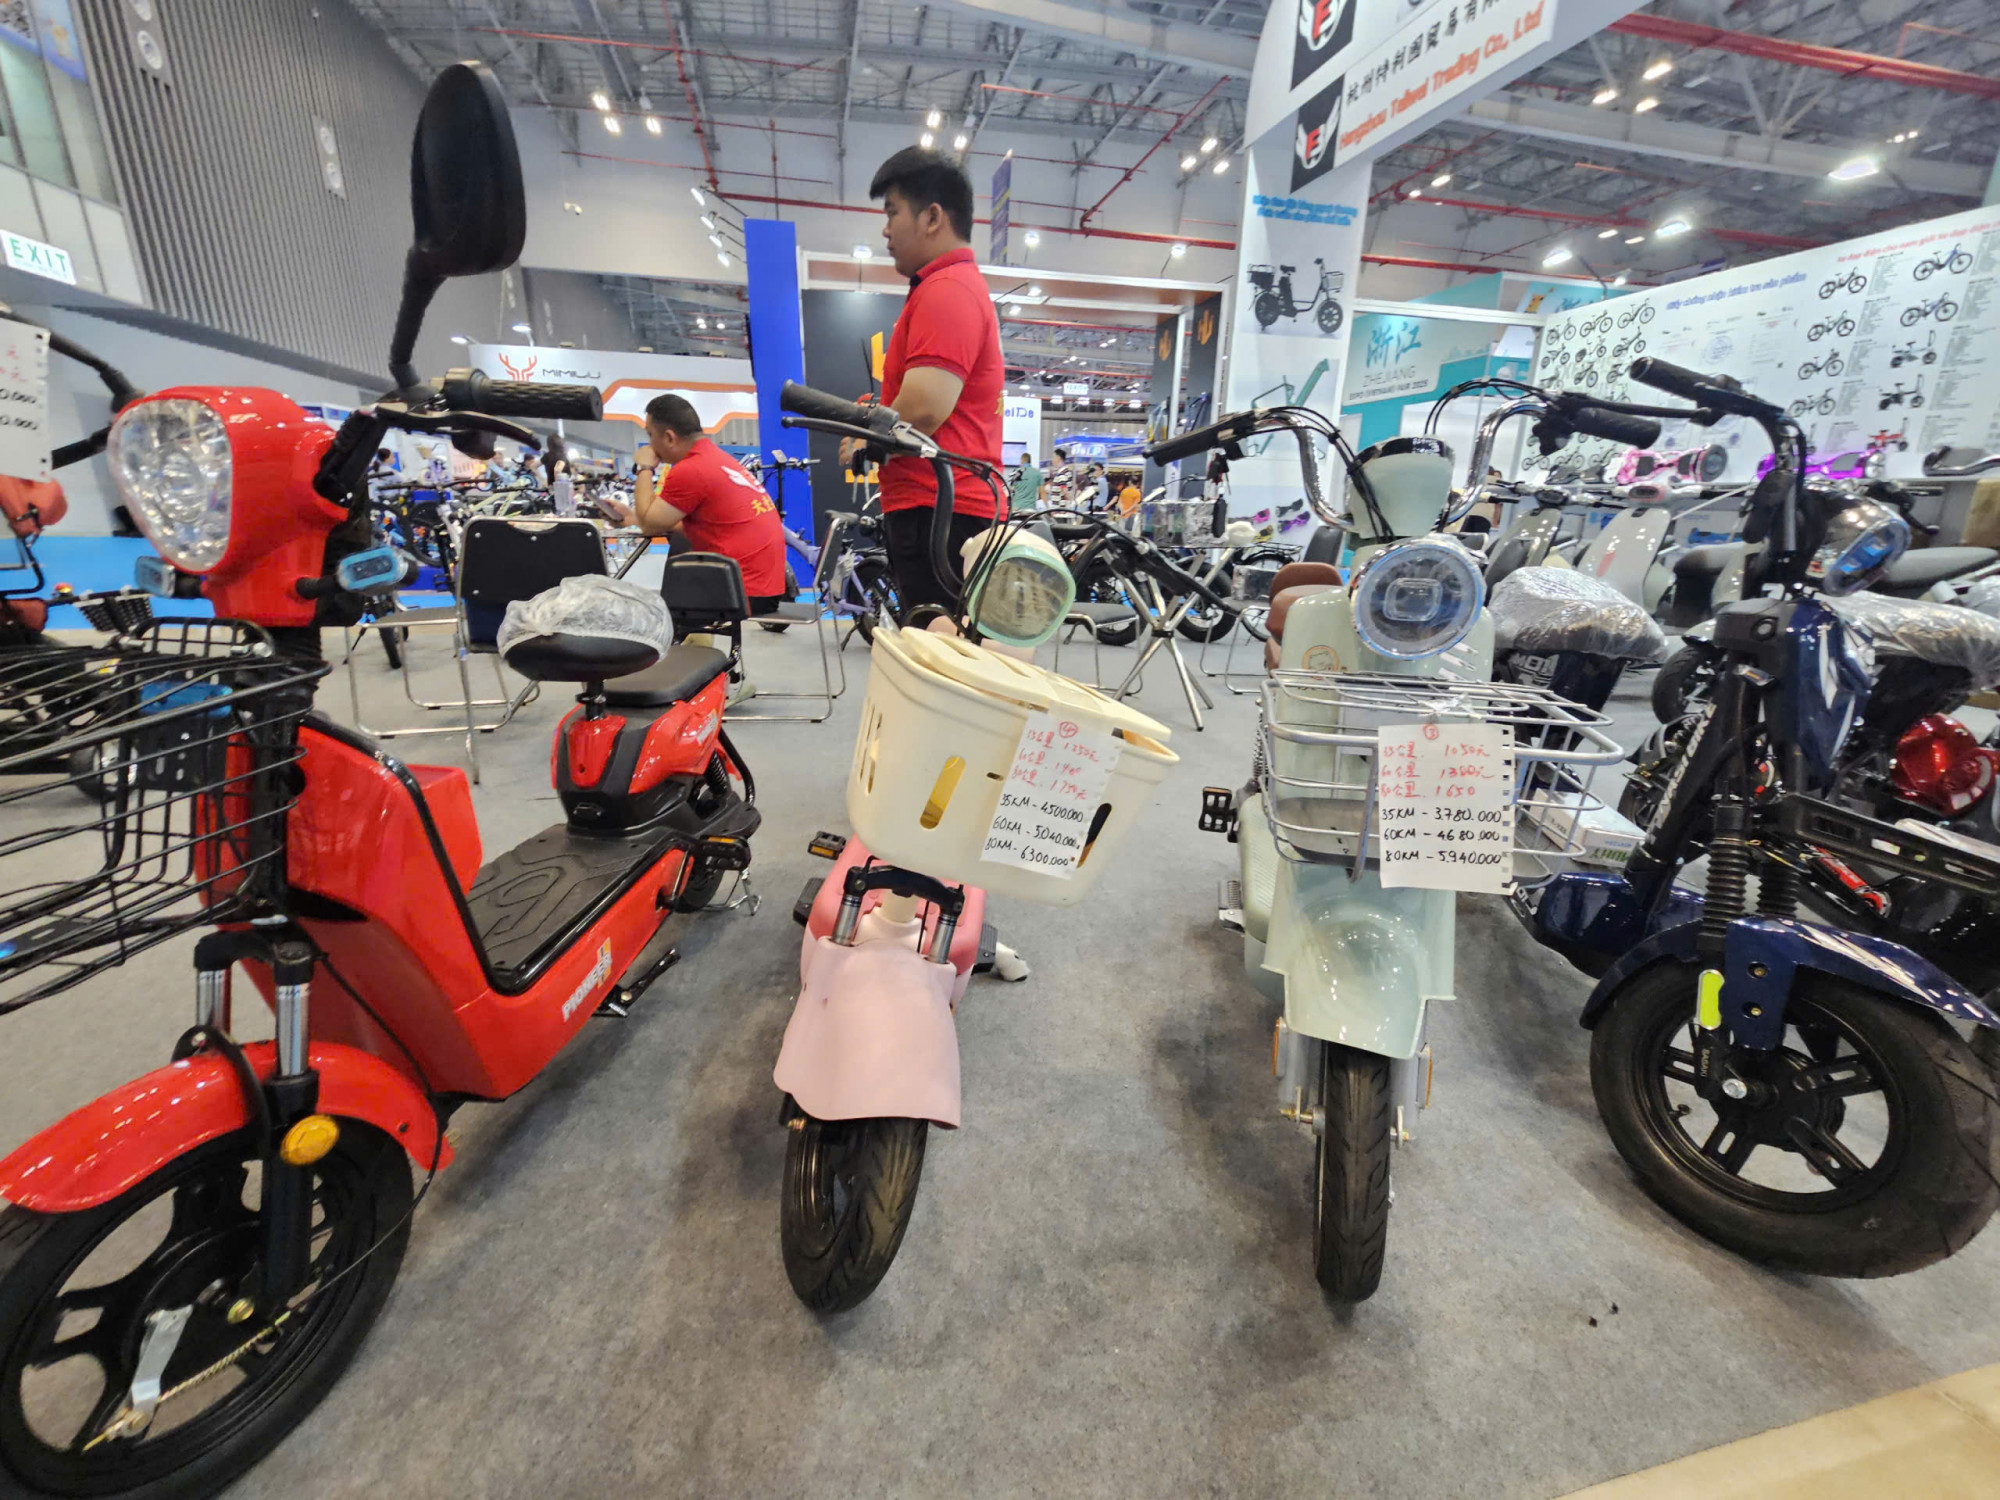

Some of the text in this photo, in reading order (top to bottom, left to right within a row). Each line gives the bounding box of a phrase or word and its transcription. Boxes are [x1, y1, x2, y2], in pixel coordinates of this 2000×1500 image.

[1432, 47, 1480, 93] Trading
[9, 237, 67, 273] EXIT
[1381, 807, 1415, 820] 35KM
[1384, 827, 1416, 839] 60KM
[1385, 850, 1419, 862] 80KM
